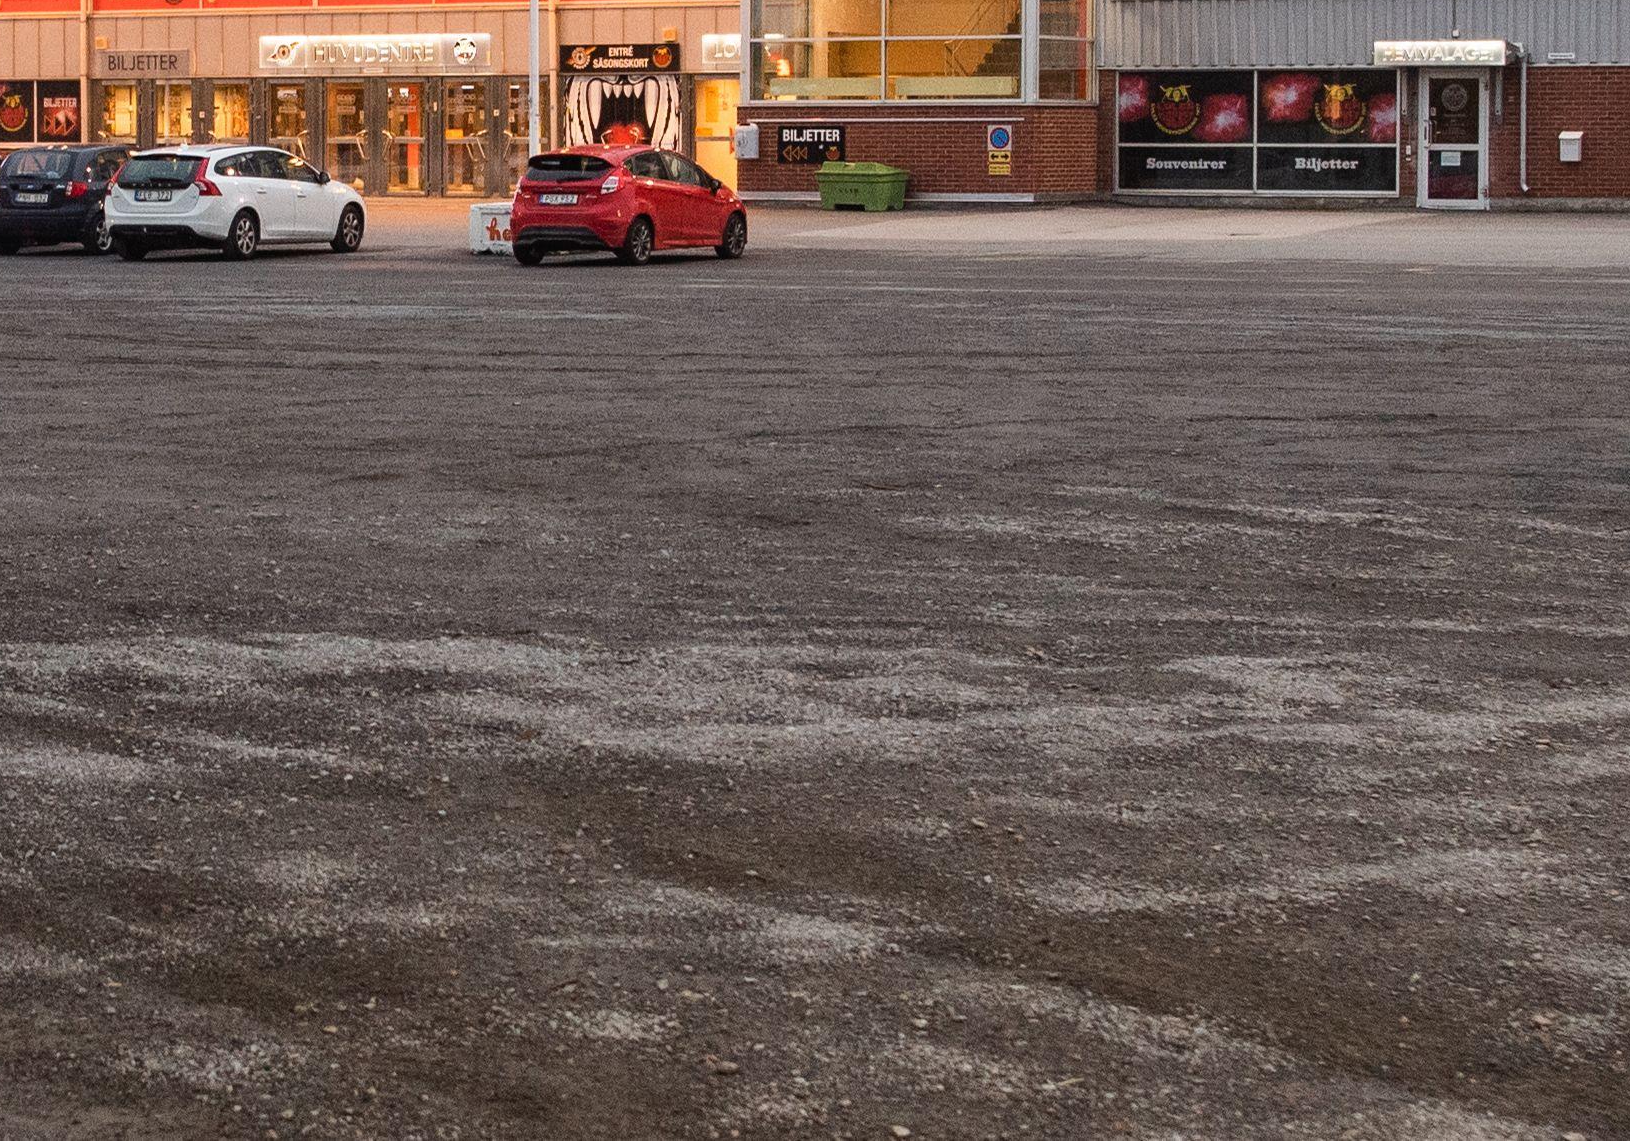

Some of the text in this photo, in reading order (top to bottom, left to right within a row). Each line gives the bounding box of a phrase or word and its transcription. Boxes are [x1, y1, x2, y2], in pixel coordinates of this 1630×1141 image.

[608, 45, 634, 57] ENTRÉ
[107, 54, 178, 71] BILJETTER
[592, 58, 650, 68] SÄSONGSKORT
[43, 98, 77, 108] BILJETTER
[782, 129, 840, 142] BILJETTER
[1146, 158, 1227, 170] Souvenirer
[1294, 158, 1359, 172] Biljetter
